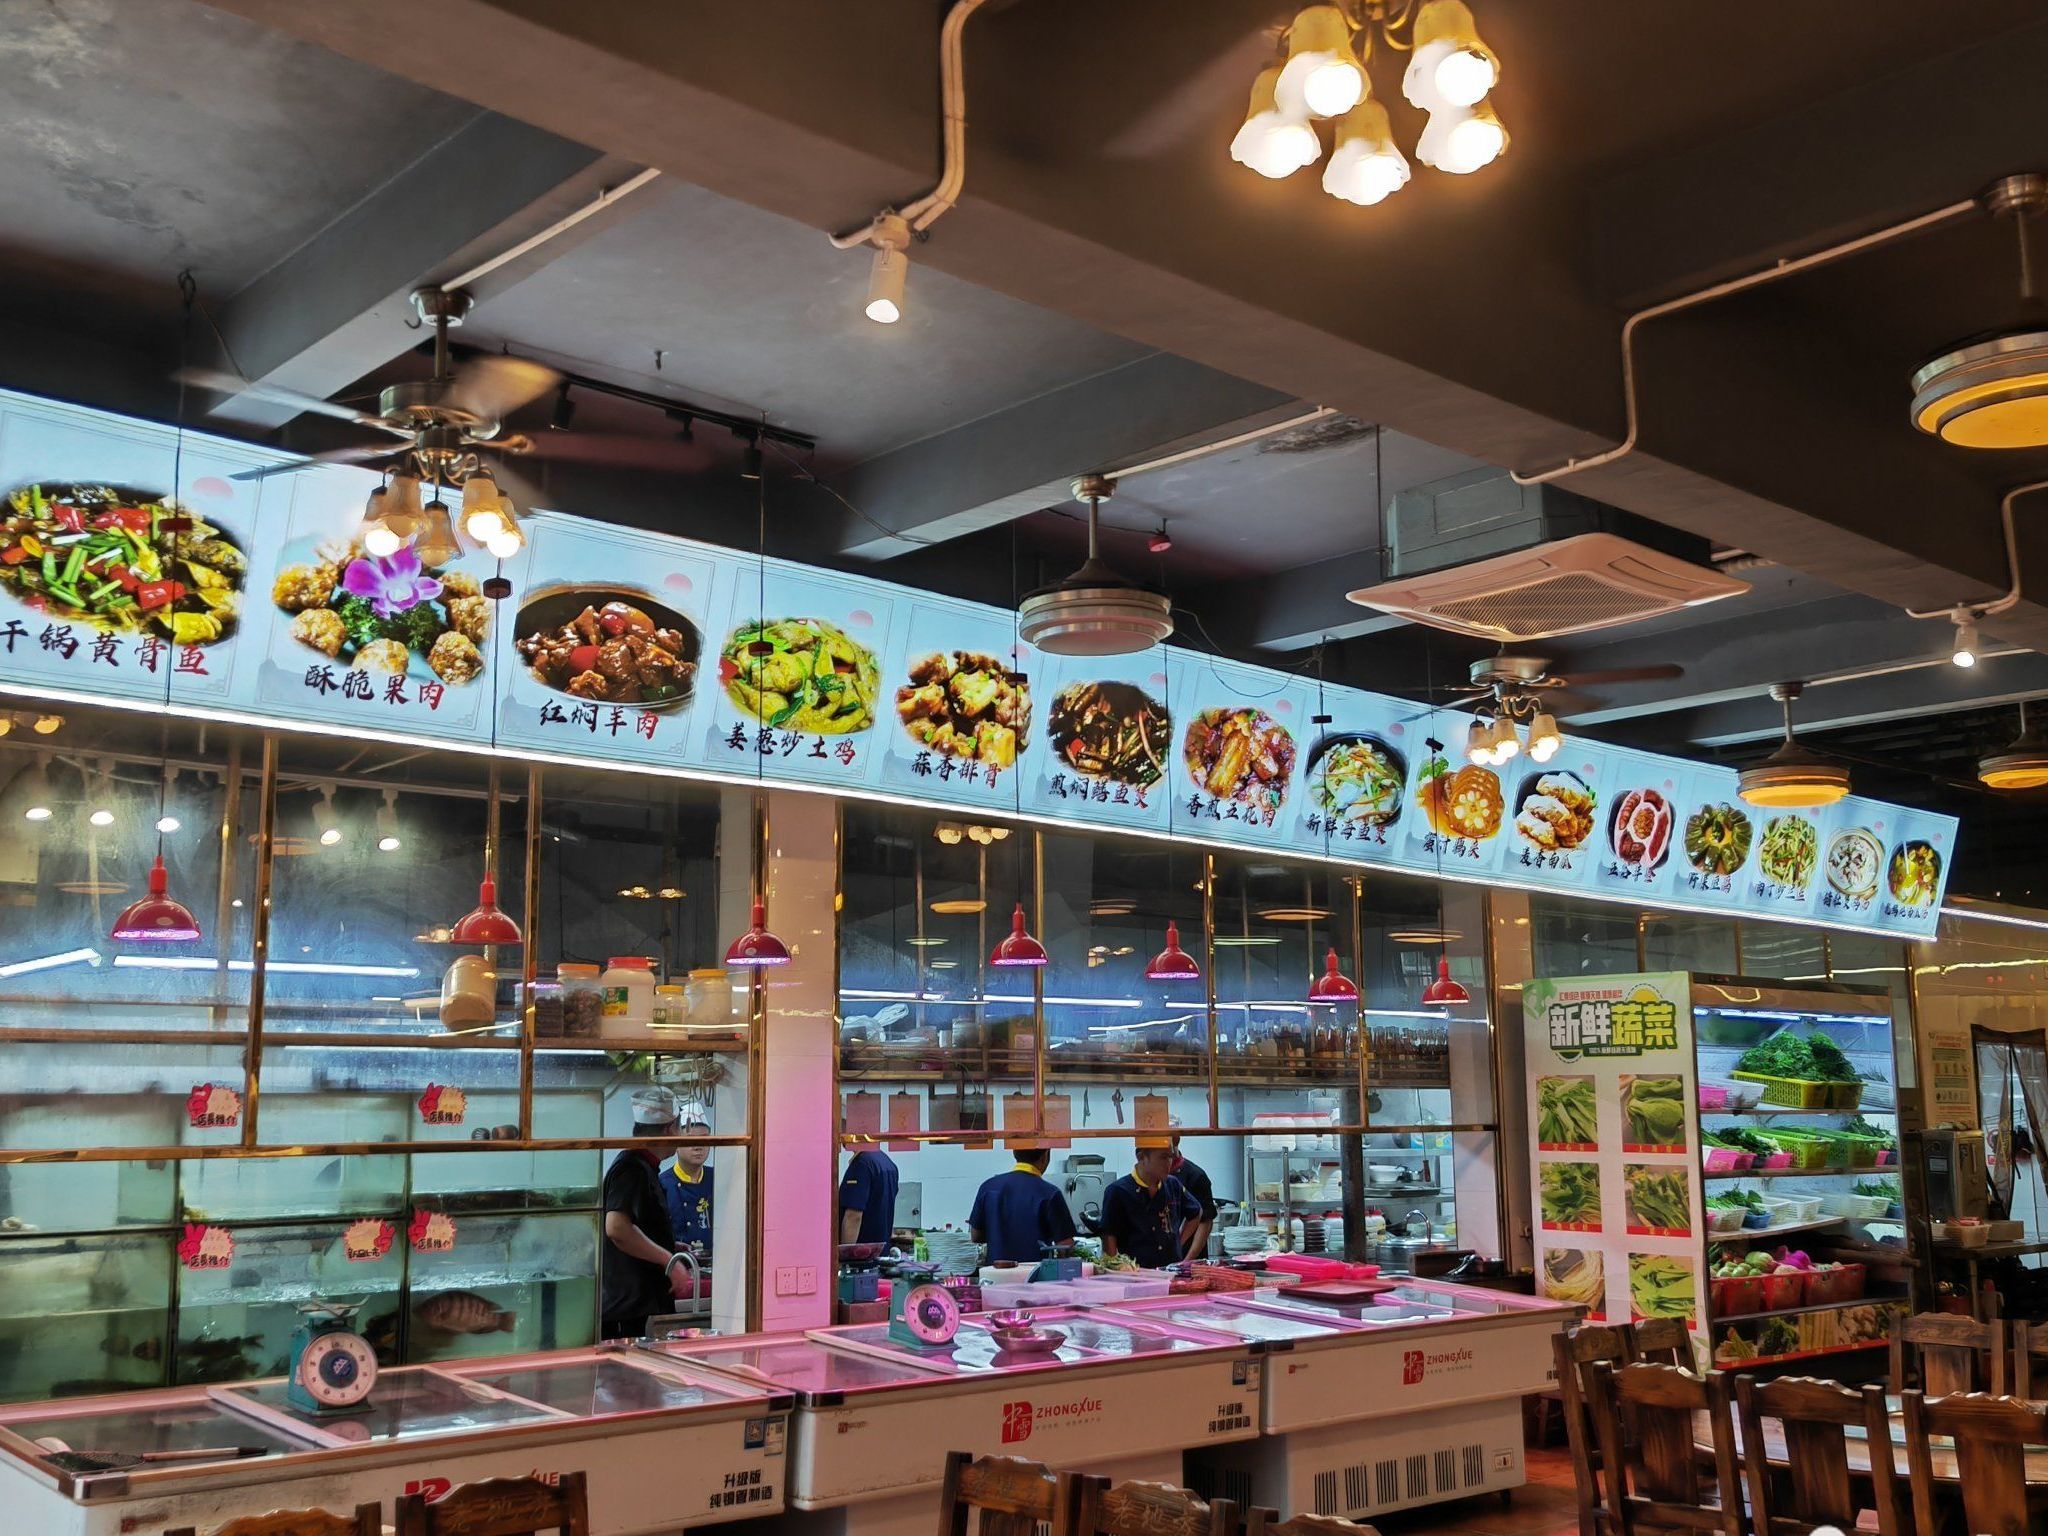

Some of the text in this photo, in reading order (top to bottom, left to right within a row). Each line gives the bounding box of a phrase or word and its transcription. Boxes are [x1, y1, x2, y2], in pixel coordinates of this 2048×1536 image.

[0, 619, 210, 676] 干锅黄骨鱼
[304, 664, 445, 711] 酥脆果肉
[540, 698, 659, 740] 红焖羊肉
[725, 721, 856, 766] 姜葱炒土鸡
[911, 750, 1002, 789] 蒜香排骨
[1549, 1001, 1677, 1050] 新鲜蔬菜
[1426, 1347, 1473, 1366] ZHONGXUE
[1036, 1396, 1102, 1419] ZHONGXUE
[724, 1469, 762, 1489] 升级版
